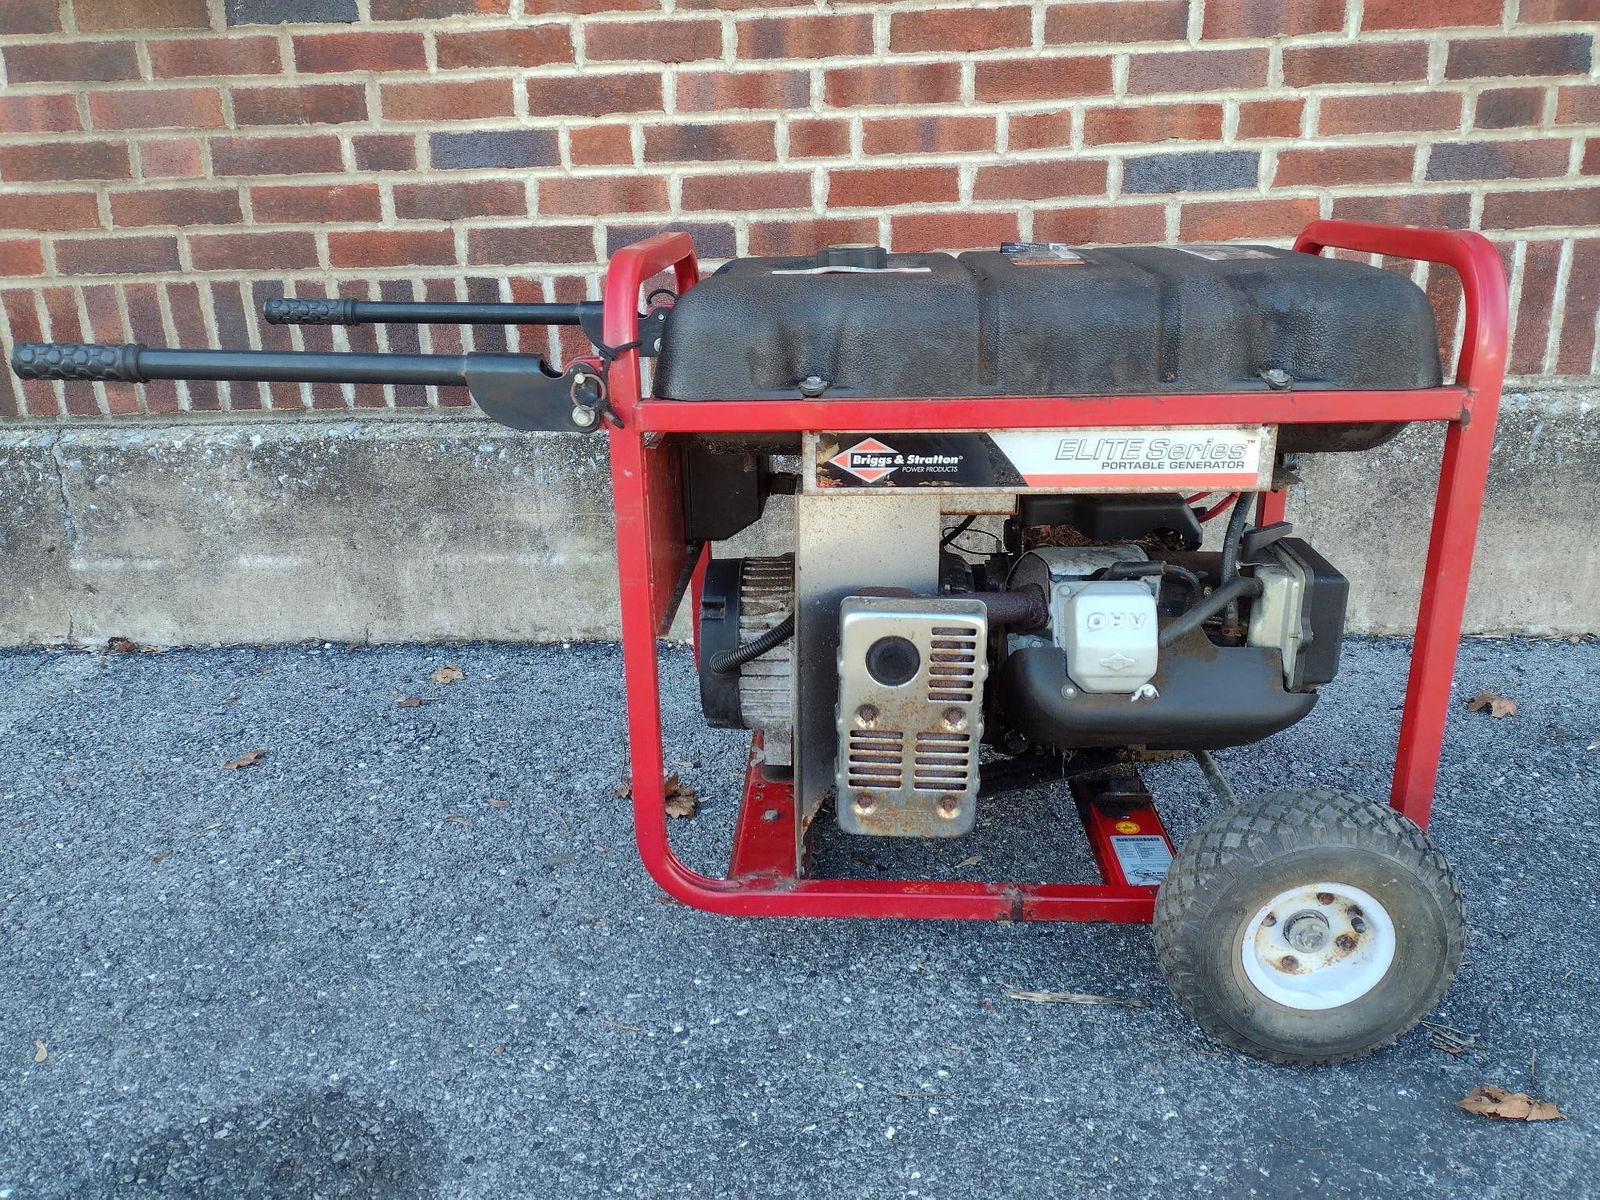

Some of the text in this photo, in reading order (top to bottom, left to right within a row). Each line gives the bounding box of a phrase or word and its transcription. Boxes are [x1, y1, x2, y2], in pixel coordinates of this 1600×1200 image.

[1054, 438, 1144, 460] ELITE
[1145, 437, 1247, 460] Series
[853, 454, 892, 467] Briggs
[894, 455, 904, 465] &
[1101, 461, 1245, 470] PORTABLE GENERATOR
